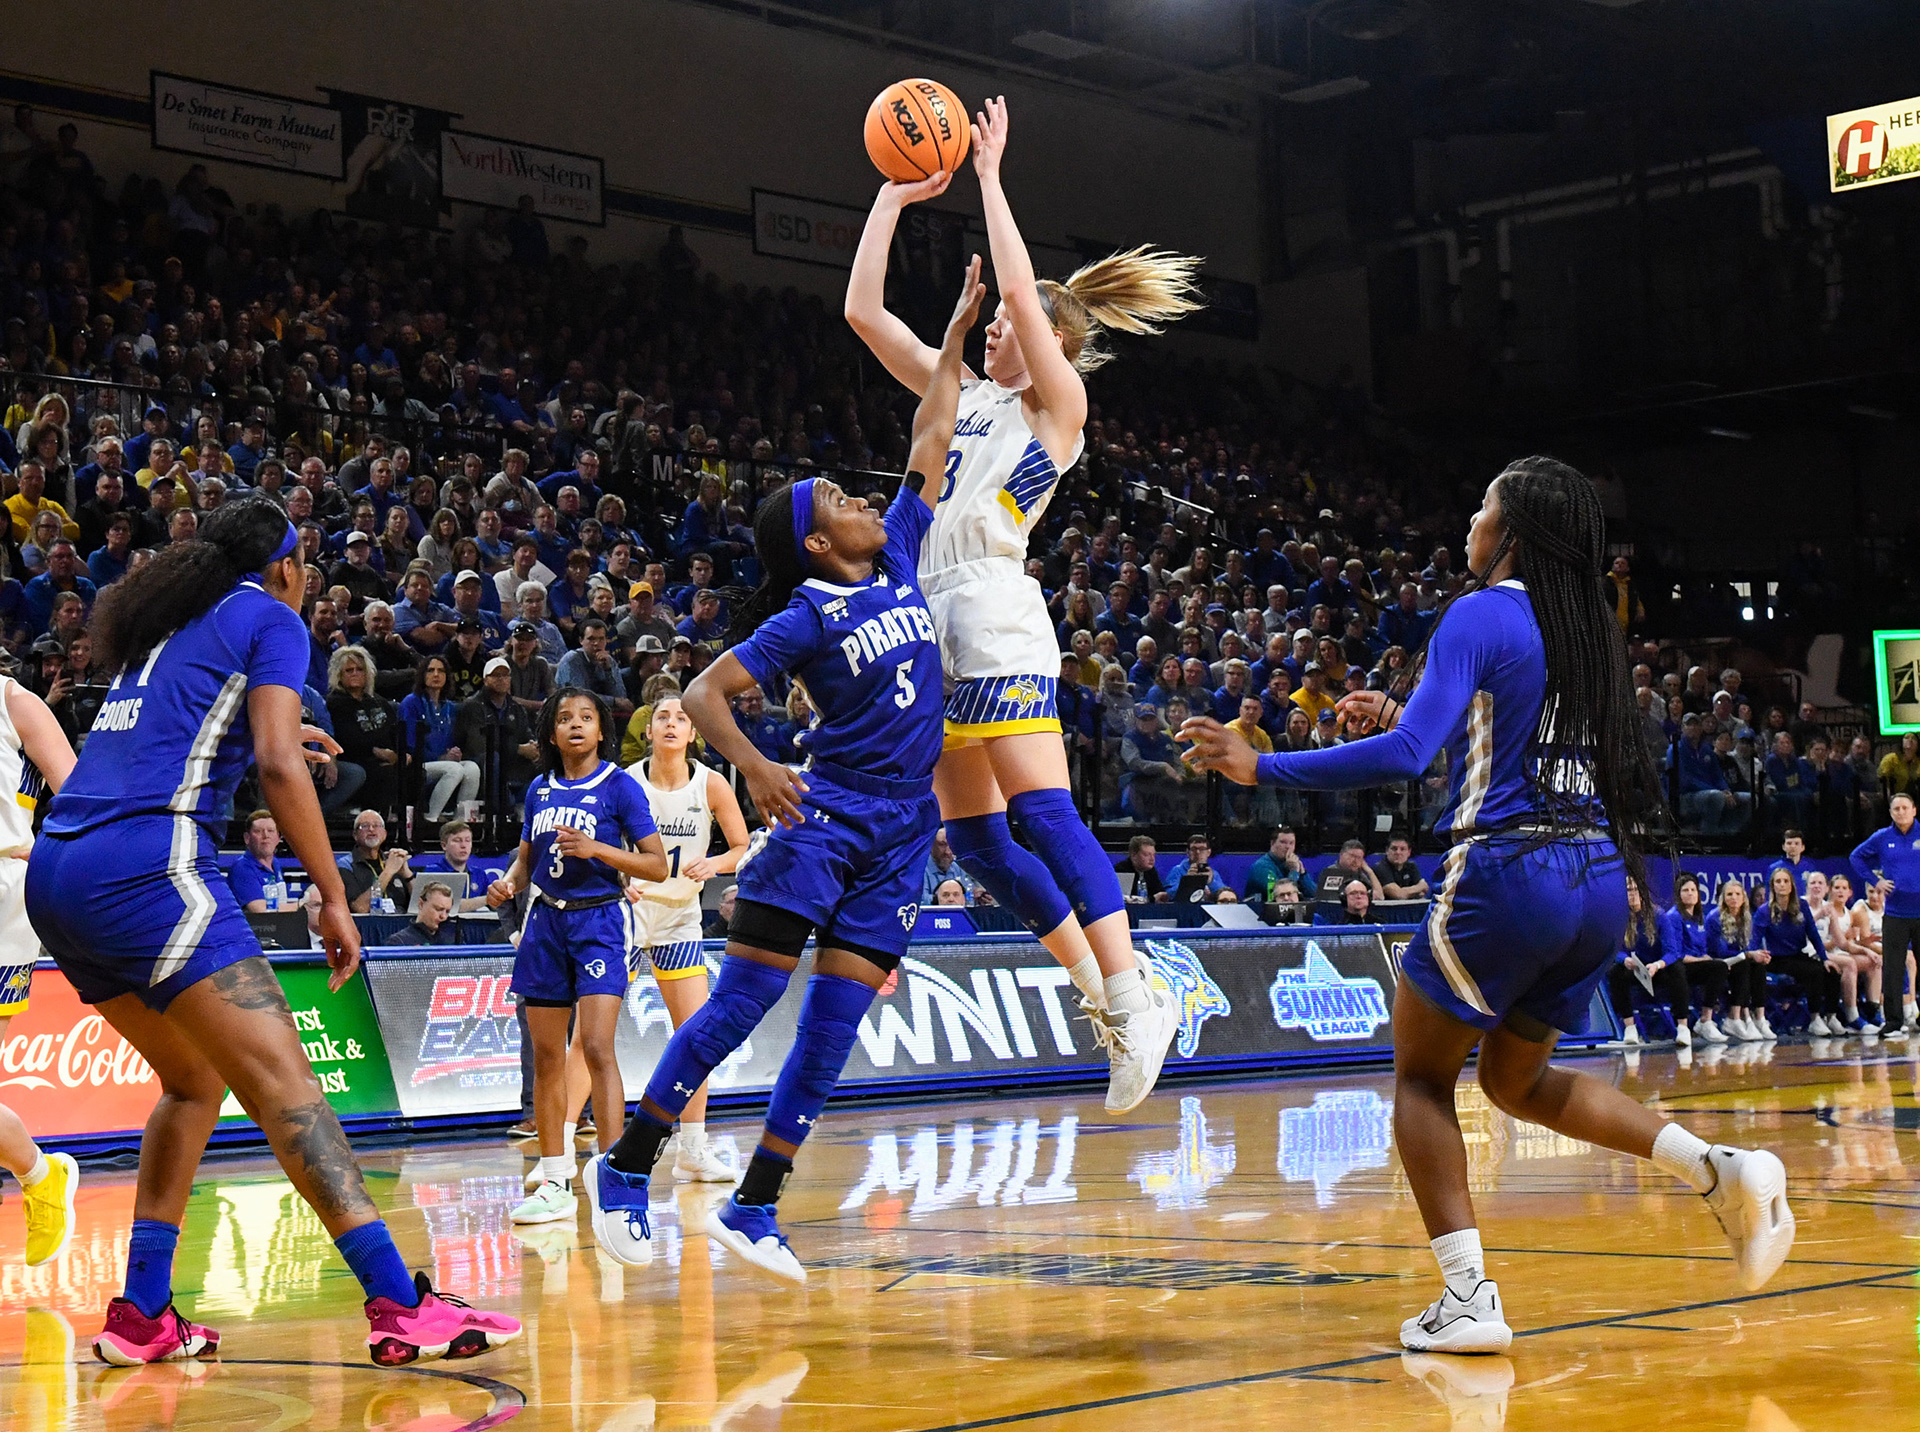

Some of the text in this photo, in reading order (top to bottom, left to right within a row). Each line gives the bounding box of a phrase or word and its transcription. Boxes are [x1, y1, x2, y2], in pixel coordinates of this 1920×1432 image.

[162, 92, 336, 141] De Smet Farm Mutual
[890, 98, 925, 147] NCAA
[188, 117, 312, 154] Insurance Company
[451, 136, 592, 191] NorthWestern
[652, 454, 674, 482] M
[840, 605, 937, 678] PIRATES
[894, 658, 916, 709] 5
[91, 697, 143, 732] COOKS
[531, 806, 598, 842] PIRATES
[655, 816, 697, 837] rabbits
[549, 842, 565, 879] 3
[934, 918, 951, 929] POSS
[1281, 973, 1307, 985] THE
[292, 1006, 325, 1031] rst
[1276, 986, 1383, 1021] SUMMIT
[1311, 1021, 1370, 1036] LEAGUE
[0, 1015, 154, 1088] ca-Cola
[345, 1038, 365, 1060] &
